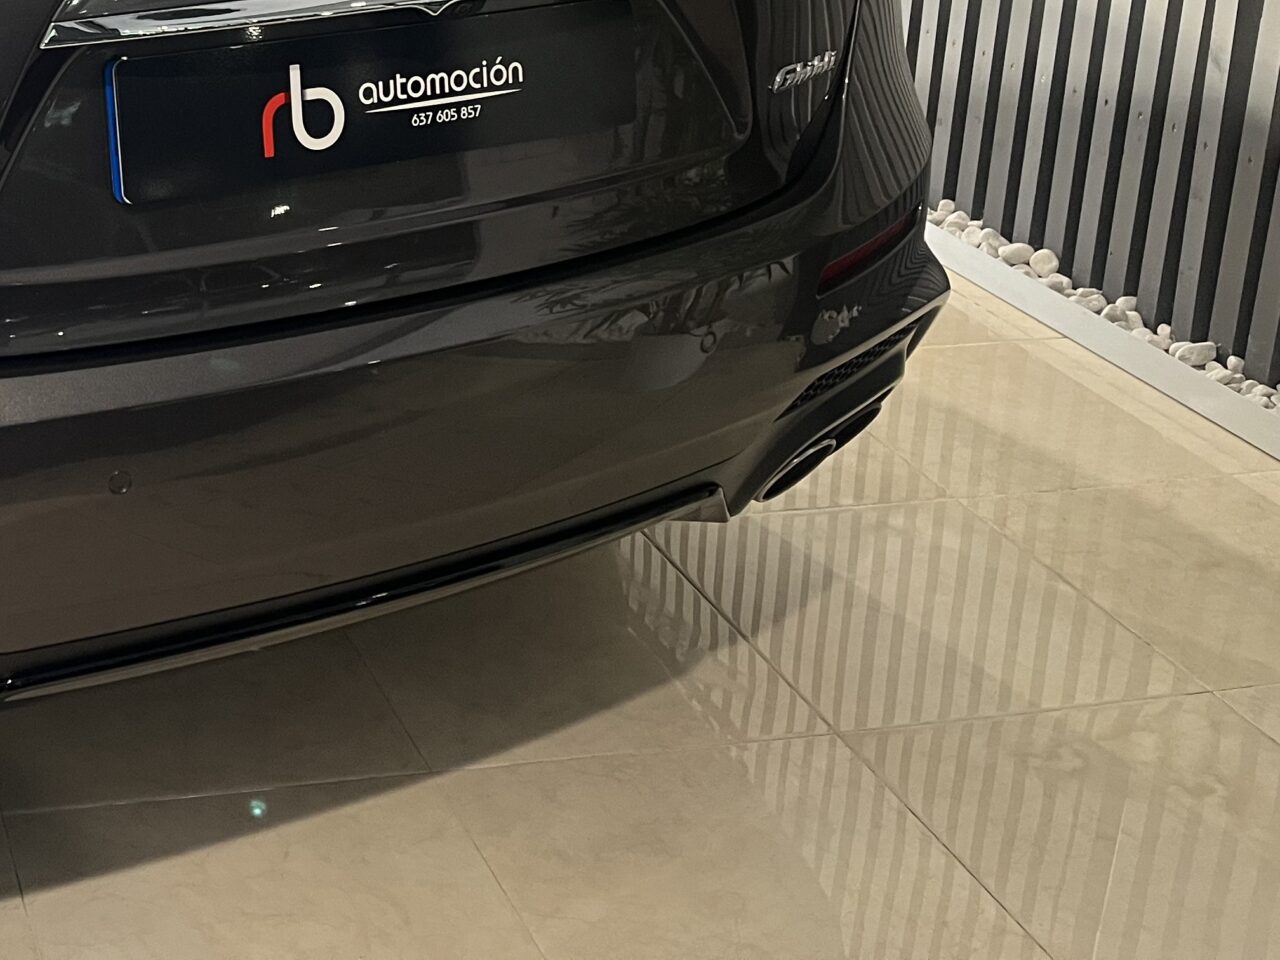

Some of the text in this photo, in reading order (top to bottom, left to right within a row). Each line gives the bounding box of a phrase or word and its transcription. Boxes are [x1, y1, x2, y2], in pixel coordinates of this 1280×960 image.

[358, 56, 524, 105] automoción
[262, 64, 345, 158] rb
[411, 105, 481, 127] 637 605 857
